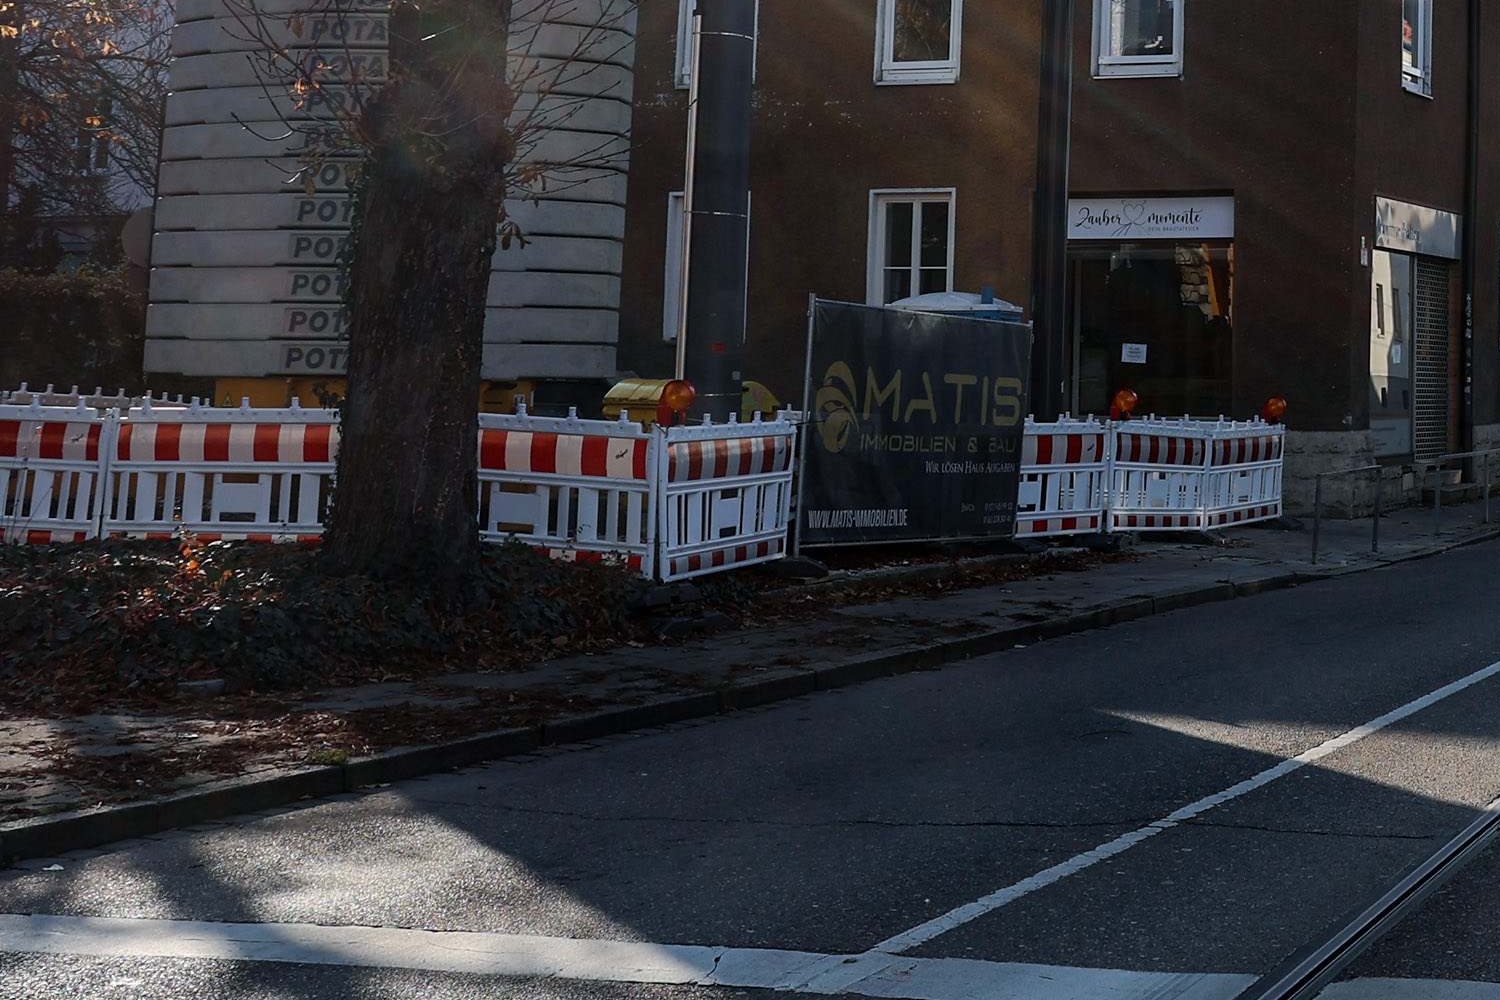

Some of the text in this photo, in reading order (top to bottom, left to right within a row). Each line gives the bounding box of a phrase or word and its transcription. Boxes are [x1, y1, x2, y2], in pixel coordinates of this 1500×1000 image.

[311, 20, 386, 40] POTA
[1147, 208, 1202, 225] momente
[863, 366, 1023, 427] MATIS
[860, 433, 1017, 454] IMMOBILIEN & BAU
[807, 508, 909, 529] WWW.MATIS-IMMOBILIEN.DE
